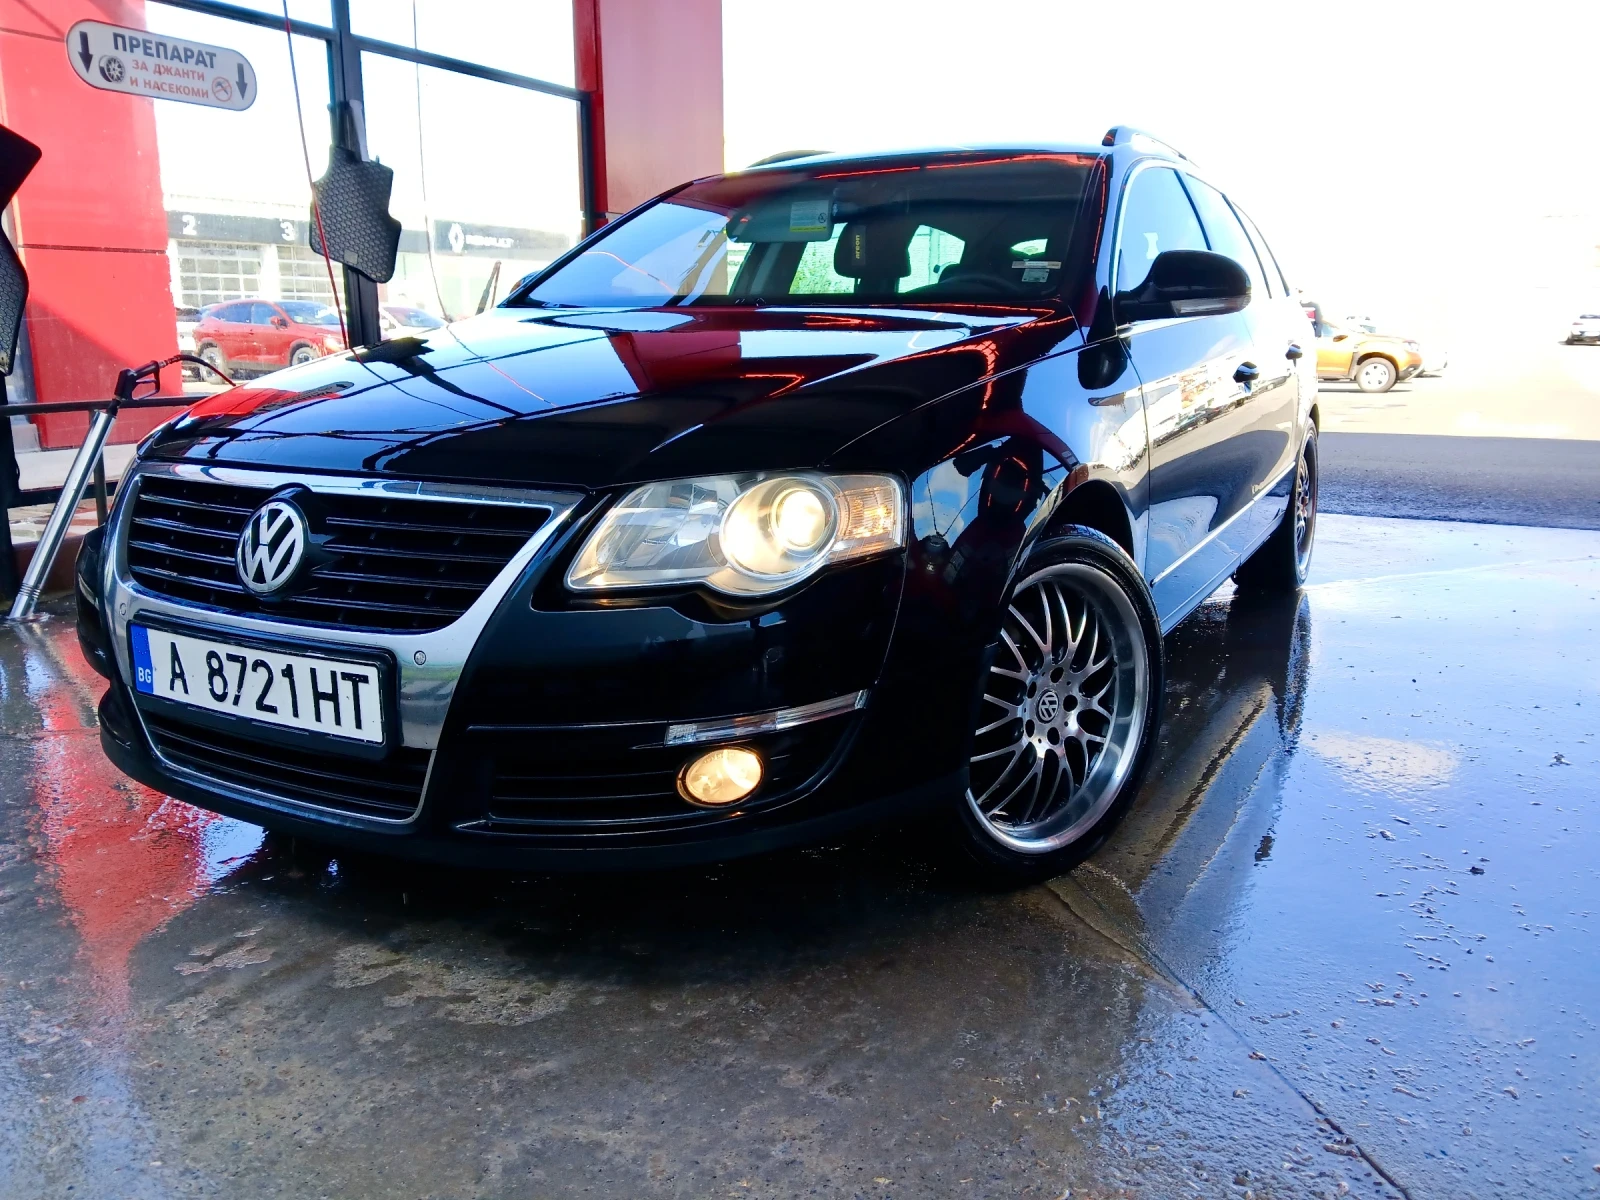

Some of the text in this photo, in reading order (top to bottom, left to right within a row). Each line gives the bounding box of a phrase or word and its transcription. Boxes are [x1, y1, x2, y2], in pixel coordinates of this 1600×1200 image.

[112, 32, 217, 69] ПРЕПАРАТ
[132, 59, 205, 82] ЗА ДЖАНТИ
[130, 76, 209, 99] И НАСЕКОМИ
[181, 214, 197, 236] 2
[280, 219, 296, 242] 3
[137, 666, 152, 684] BG
[170, 641, 190, 695] A
